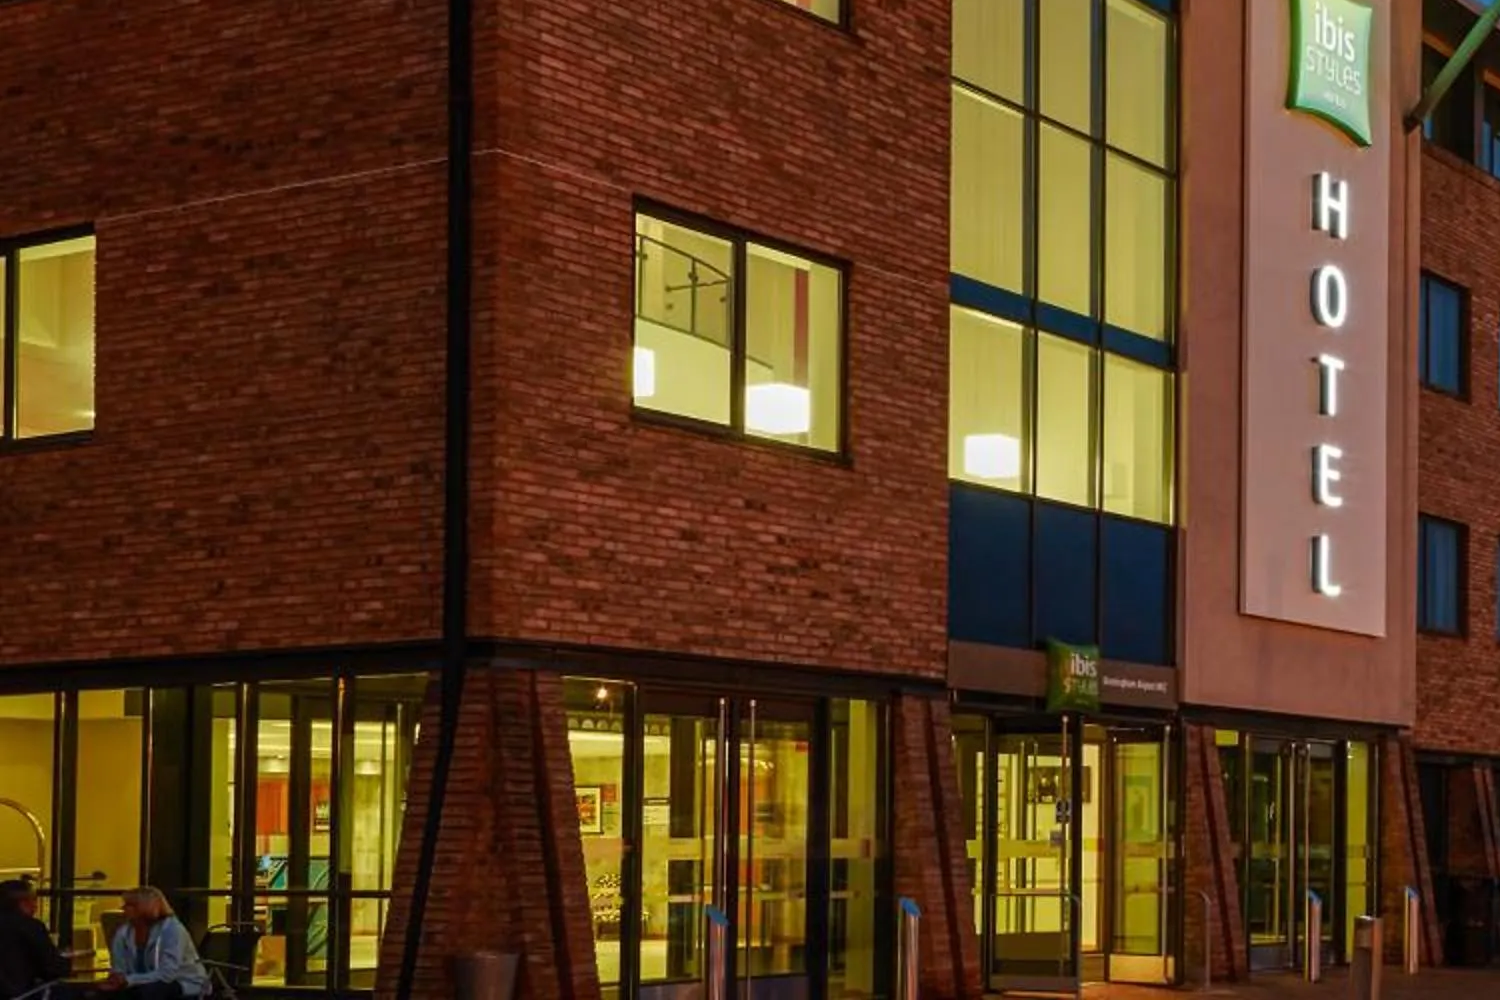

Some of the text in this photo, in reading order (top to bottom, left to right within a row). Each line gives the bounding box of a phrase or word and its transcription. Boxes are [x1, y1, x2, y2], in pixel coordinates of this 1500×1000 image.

[1314, 0, 1356, 63] ibis
[1314, 171, 1348, 597] HOTEL
[1070, 652, 1098, 678] ibis
